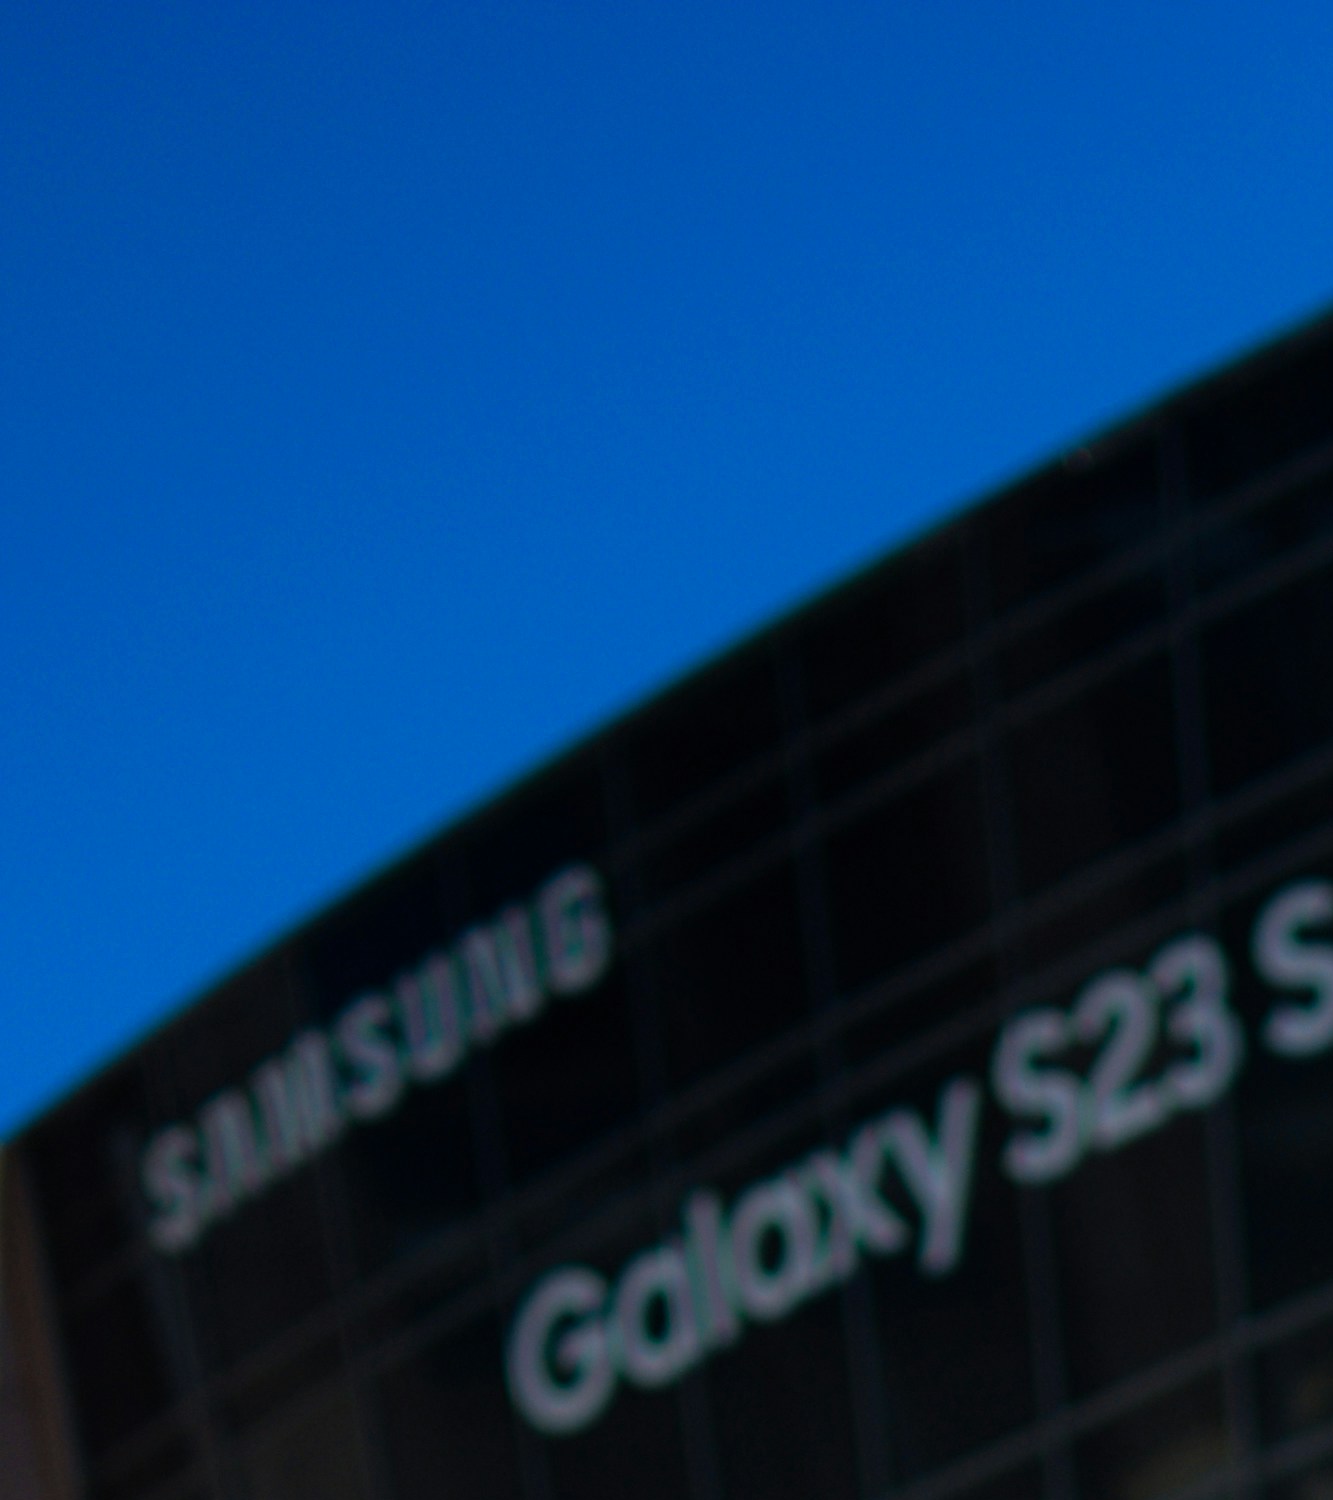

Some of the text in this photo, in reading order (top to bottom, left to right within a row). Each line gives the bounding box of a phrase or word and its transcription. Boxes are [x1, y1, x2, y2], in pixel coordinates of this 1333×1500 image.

[143, 866, 612, 1254] SAMSUNG
[508, 1080, 980, 1433] Galaxy
[992, 934, 1242, 1184] S23
